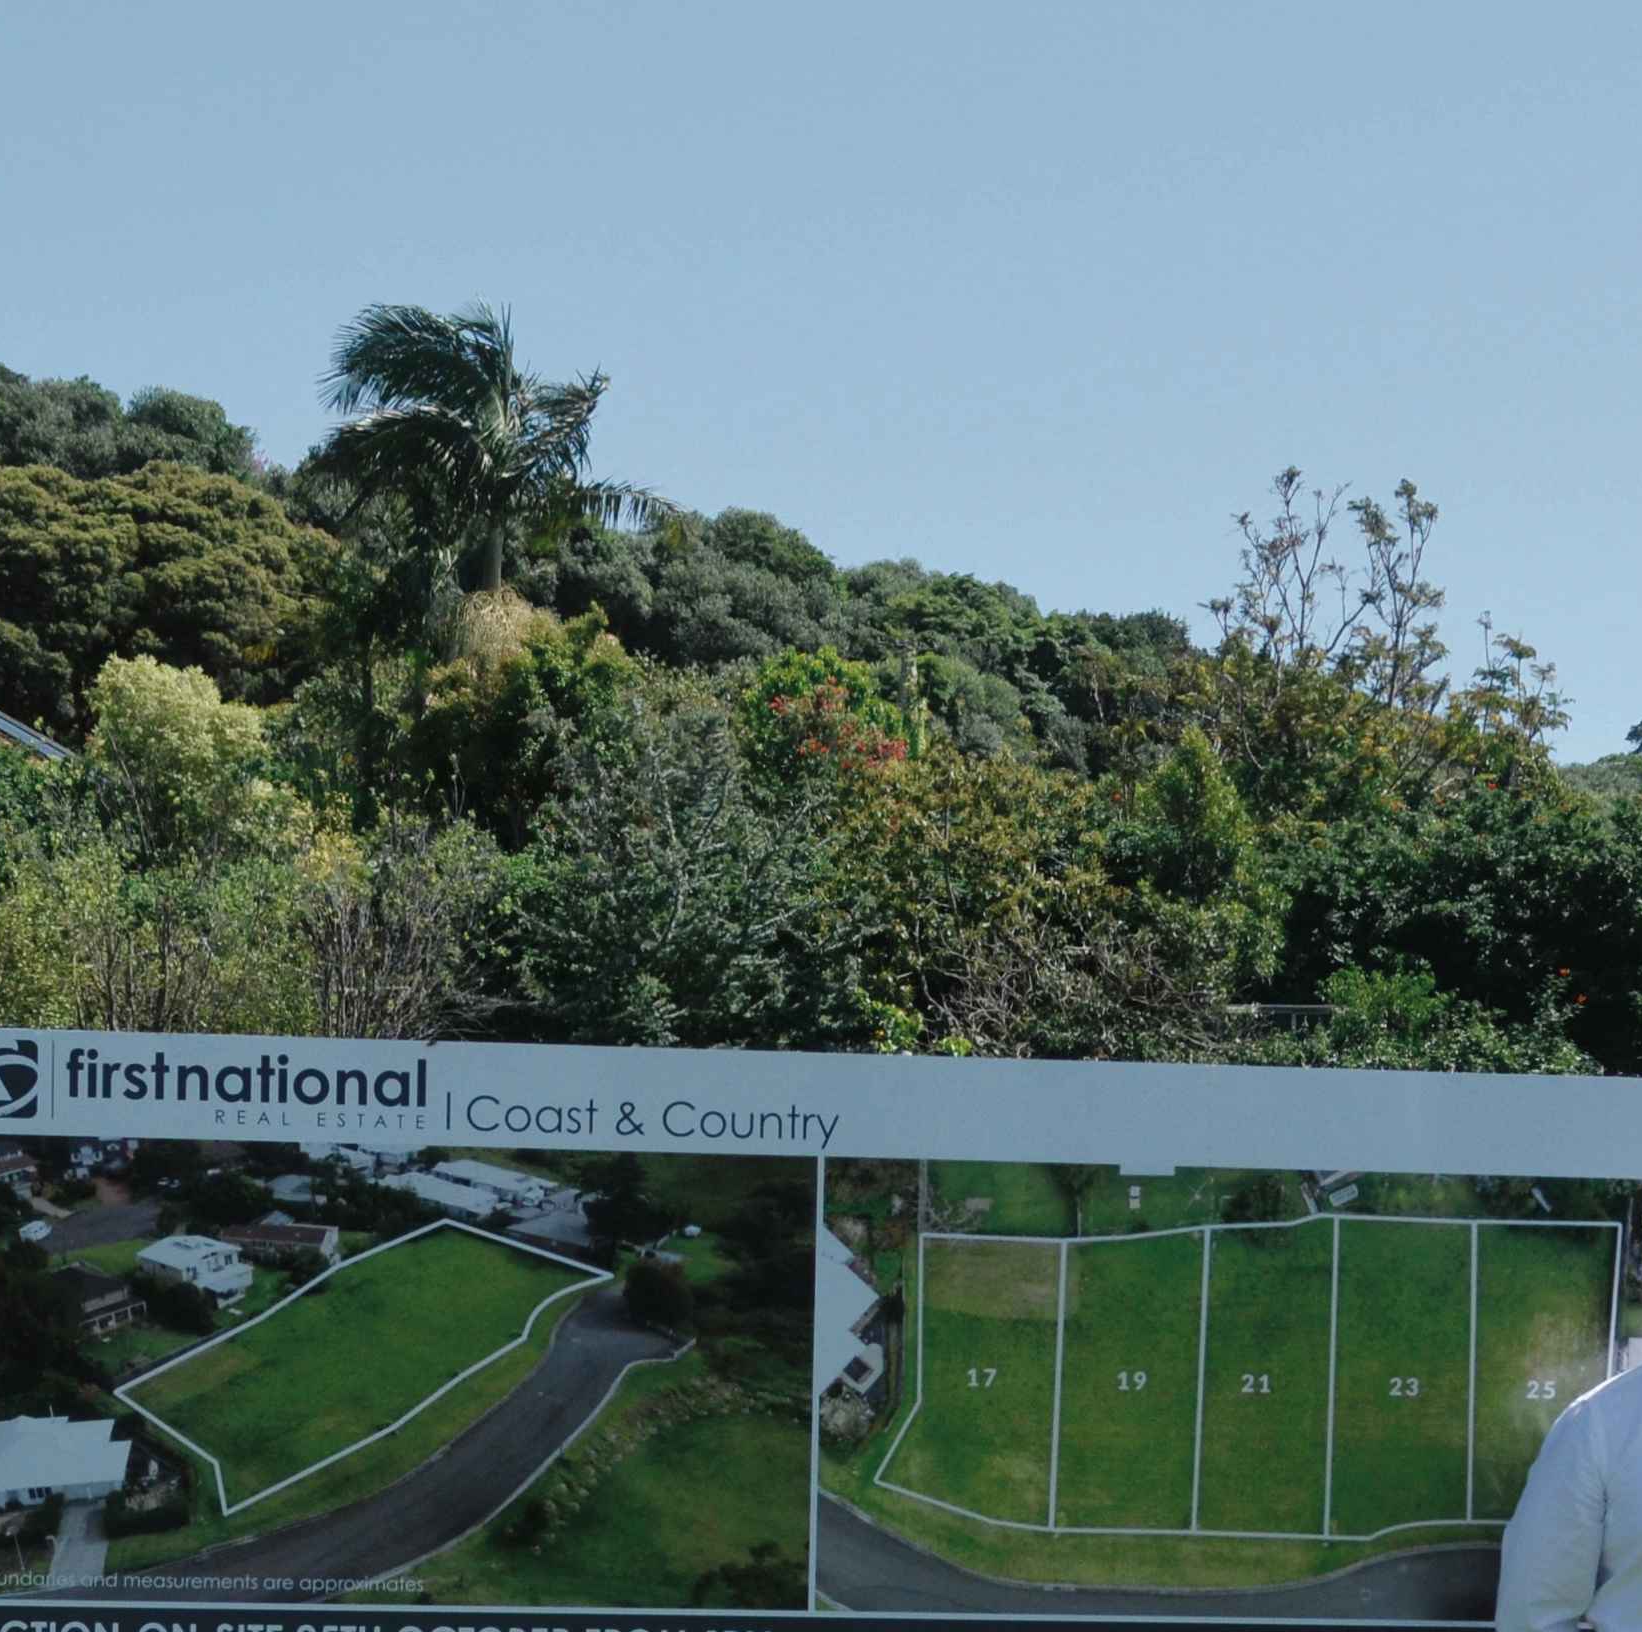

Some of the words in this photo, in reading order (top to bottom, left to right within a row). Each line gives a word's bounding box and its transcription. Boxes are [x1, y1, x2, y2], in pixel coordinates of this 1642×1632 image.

[214, 1109, 291, 1127] REAL
[316, 1112, 426, 1130] ESTATE
[466, 1094, 599, 1135] Coast
[614, 1101, 646, 1137] &
[662, 1100, 840, 1150] Country
[967, 1368, 997, 1388] 17
[1117, 1371, 1147, 1392] 19
[1241, 1373, 1271, 1394] 21
[1389, 1377, 1420, 1397] 23
[1526, 1380, 1557, 1399] 25
[80, 1572, 118, 1588] and
[122, 1573, 259, 1591] measurements
[263, 1576, 295, 1591] are
[298, 1575, 424, 1595] approximates
